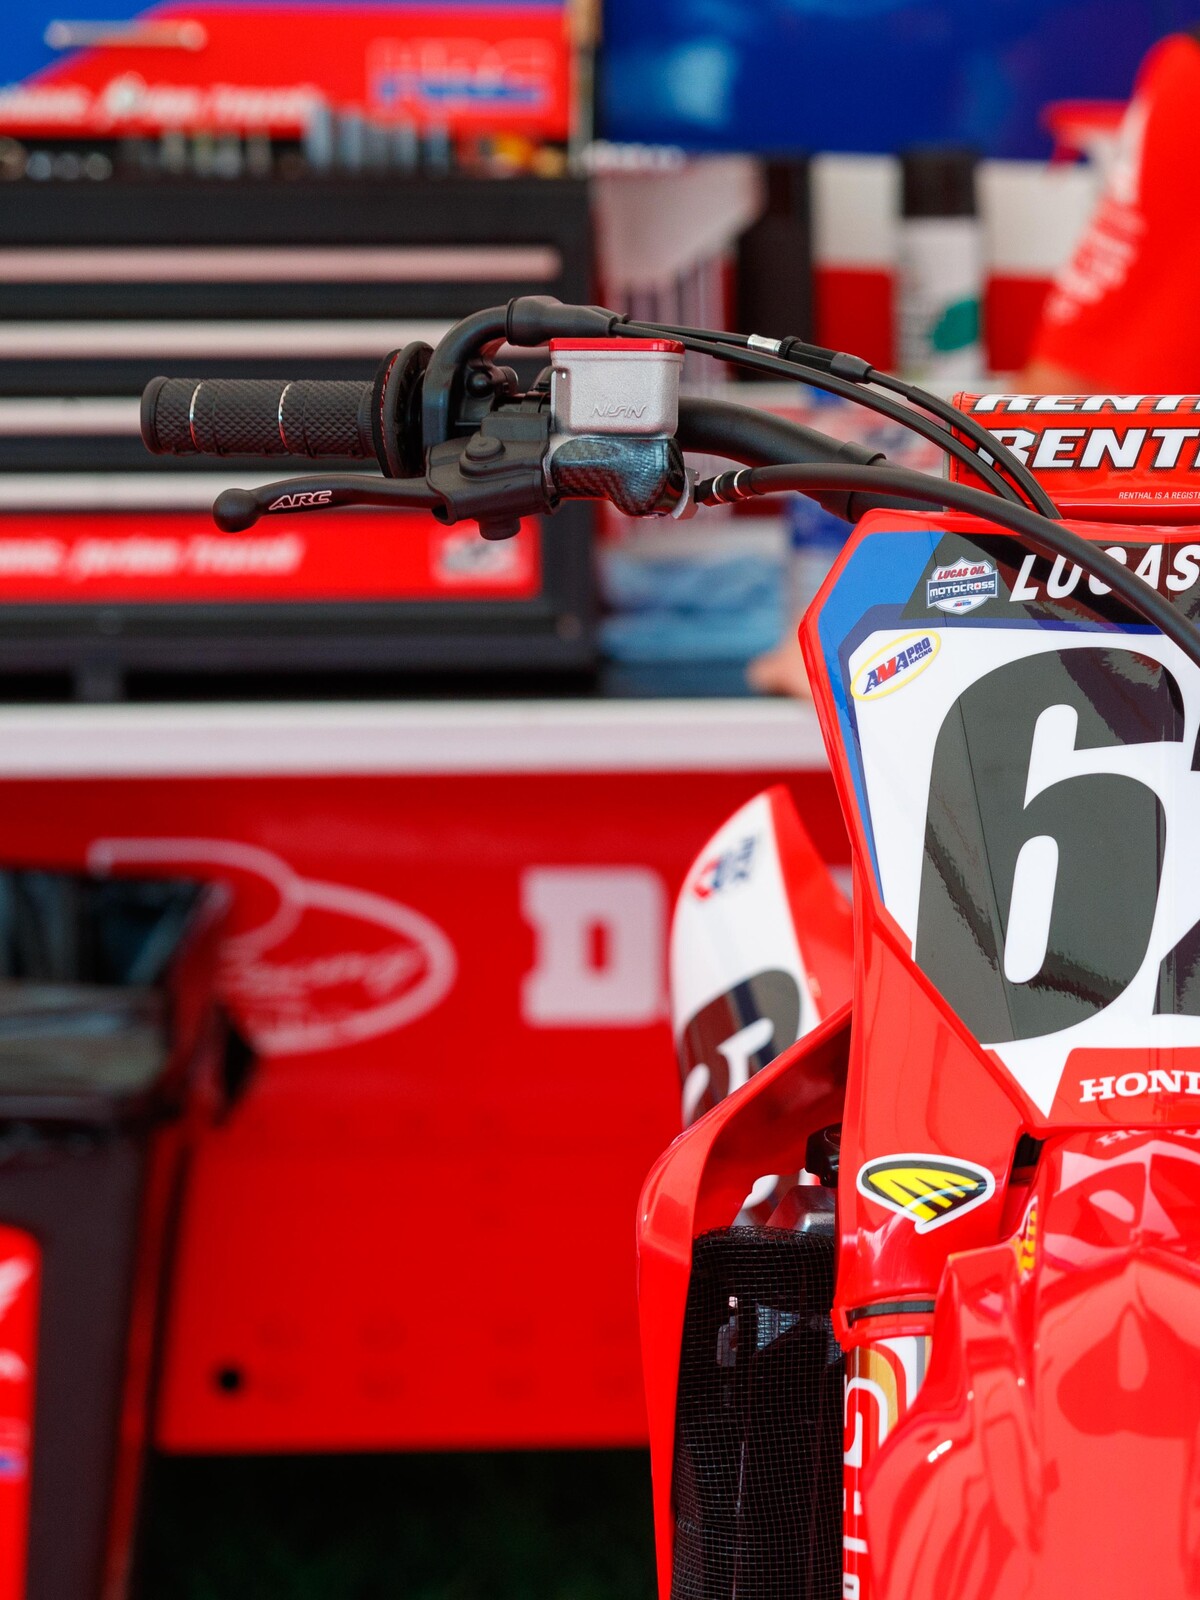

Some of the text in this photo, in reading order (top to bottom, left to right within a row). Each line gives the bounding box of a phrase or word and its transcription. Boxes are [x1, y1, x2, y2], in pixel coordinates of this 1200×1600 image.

[268, 490, 333, 511] ARC
[937, 565, 986, 580] LUCAS OIL
[929, 580, 995, 597] MOTOCROSS
[909, 647, 933, 664] RACING
[863, 637, 931, 695] AMA PRO
